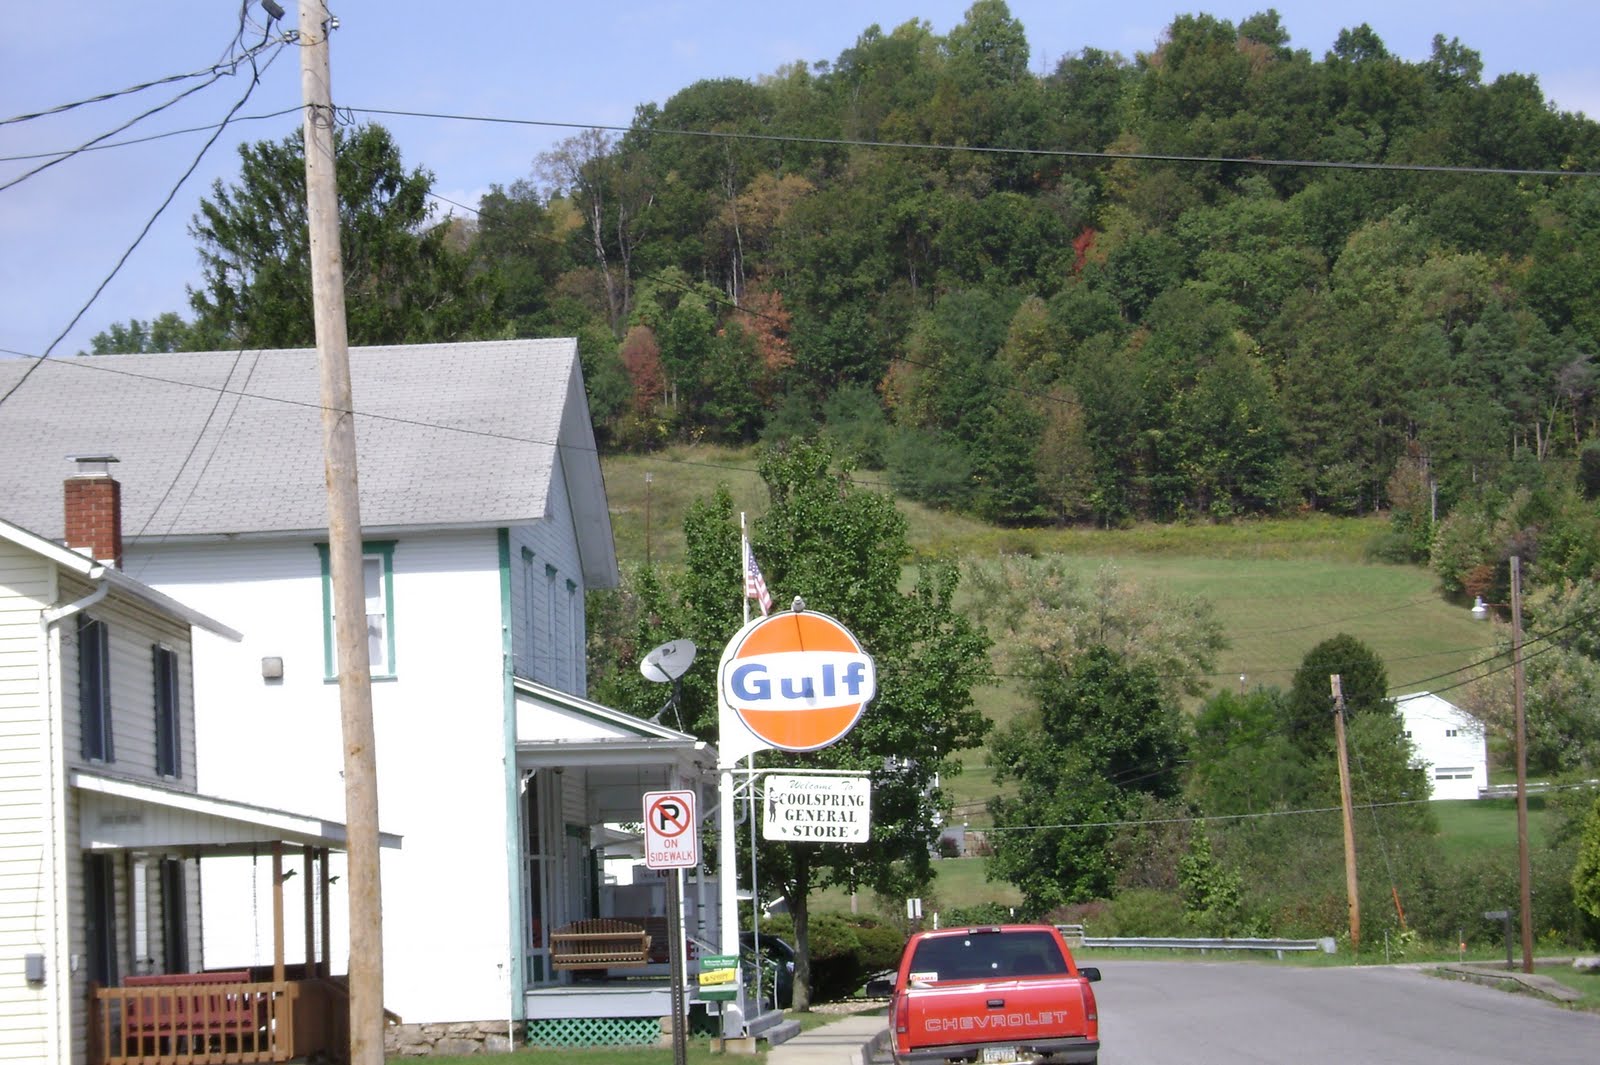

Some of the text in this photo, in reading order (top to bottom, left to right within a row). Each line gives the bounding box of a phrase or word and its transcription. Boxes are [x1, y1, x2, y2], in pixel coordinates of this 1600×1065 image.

[730, 662, 866, 701] Gulf
[789, 779, 854, 791] Welcome To
[779, 792, 865, 807] COOLSPRING
[785, 808, 858, 823] GENERAL
[792, 824, 849, 838] STORE
[663, 838, 679, 850] ON
[650, 850, 694, 863] SIDEWALK
[925, 1010, 1068, 1032] CHEVROLET
